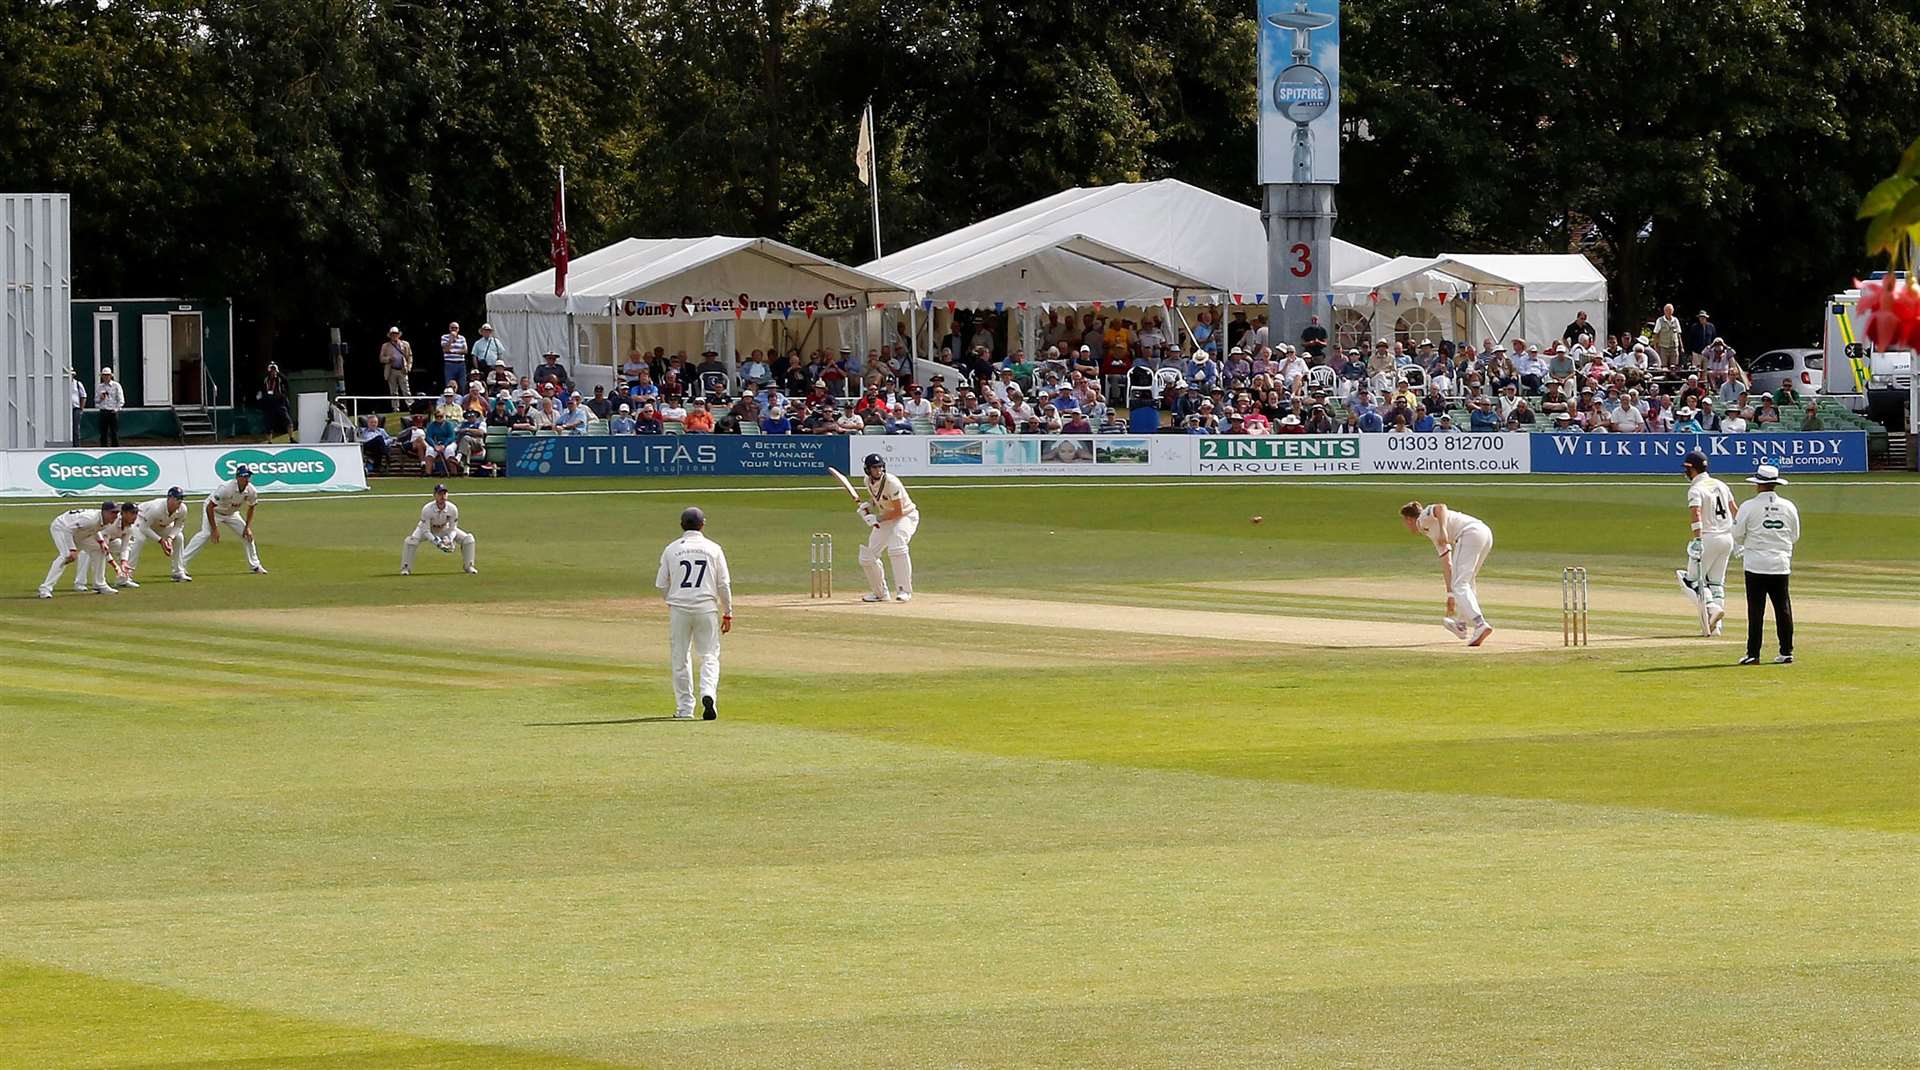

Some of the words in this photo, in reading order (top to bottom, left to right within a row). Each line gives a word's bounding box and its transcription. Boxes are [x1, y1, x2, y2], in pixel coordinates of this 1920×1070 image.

[1280, 88, 1324, 100] SPITFIRE
[1290, 243, 1312, 277] 3
[625, 301, 676, 317] Couny
[823, 292, 857, 310] Club
[1203, 441, 1218, 457] 2
[1227, 441, 1257, 457] IN
[1266, 440, 1356, 456] TENTS
[1388, 436, 1438, 451] 01303
[1445, 436, 1503, 451] 812700
[1551, 436, 1685, 456] WILKINS
[1710, 436, 1842, 456] KENNEDY
[564, 445, 717, 465] UTILITAS
[1374, 457, 1519, 472] www.2intents.co.uk
[1795, 457, 1844, 466] company
[48, 462, 149, 481] Specsavers
[1199, 462, 1303, 473] MARQUEE
[1314, 462, 1360, 471] HIRE
[1715, 496, 1726, 520] 4
[680, 560, 707, 589] 27
